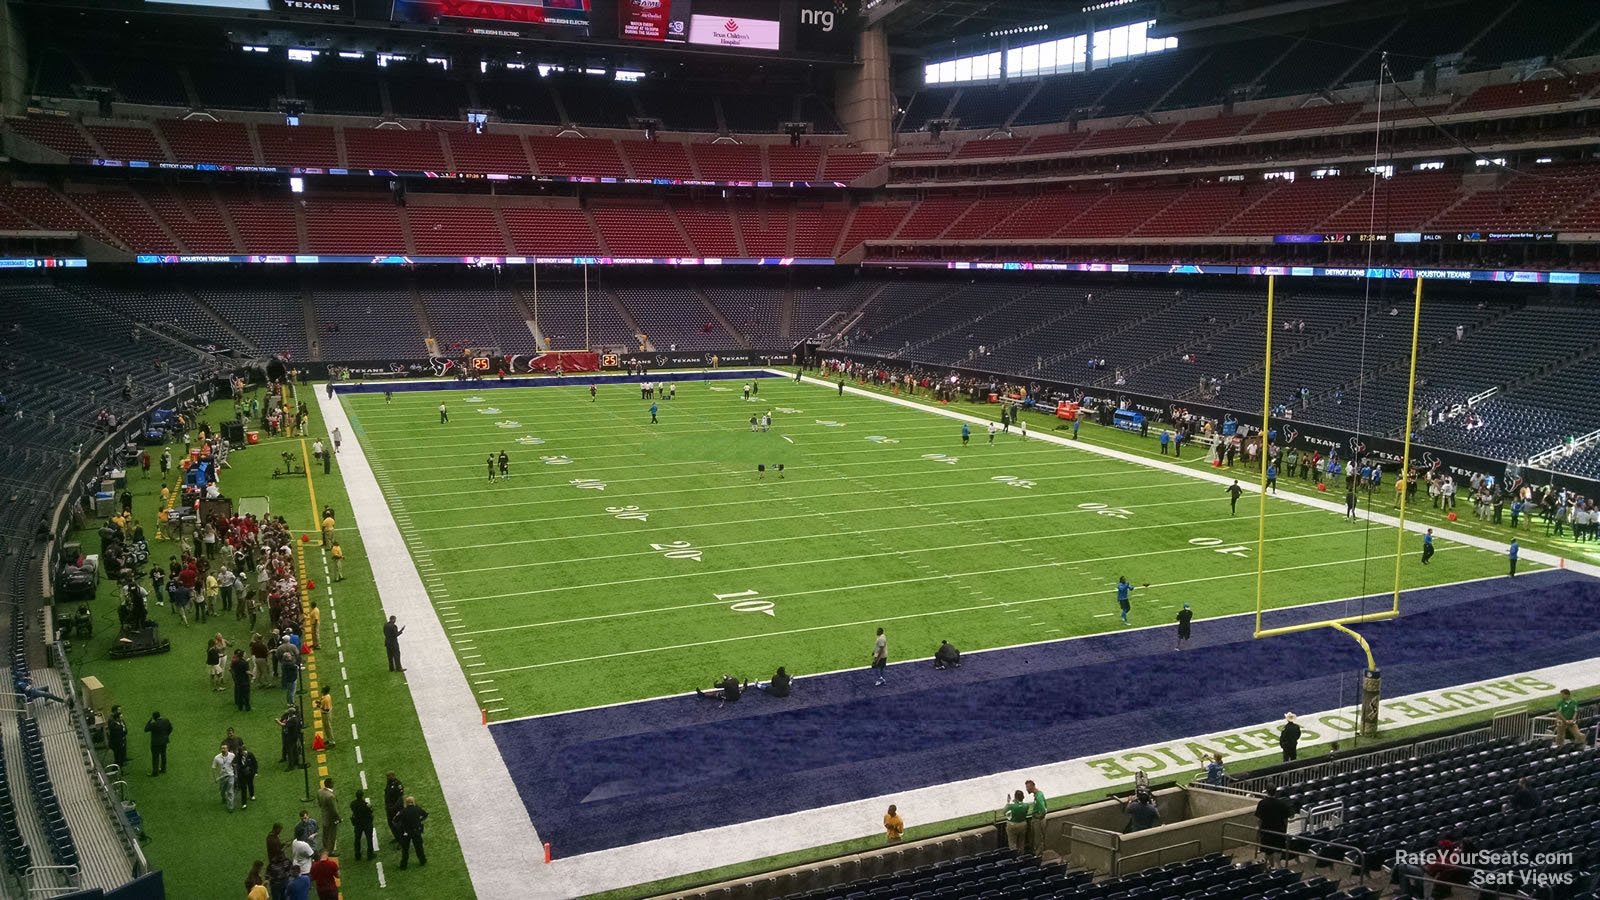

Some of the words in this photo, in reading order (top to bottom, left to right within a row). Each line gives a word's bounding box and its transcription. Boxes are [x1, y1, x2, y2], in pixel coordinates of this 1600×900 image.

[284, 0, 340, 11] TEXANS
[801, 8, 834, 32] nrg
[720, 38, 740, 46] Hospital
[475, 360, 487, 368] 25
[604, 356, 616, 365] 25
[1136, 404, 1164, 414] TEXANS
[1304, 435, 1341, 449] TEXANS
[605, 505, 649, 520] 30
[650, 540, 703, 559] 20
[1188, 537, 1252, 553] 10
[713, 589, 775, 612] 10
[1384, 676, 1556, 719] SALUTE
